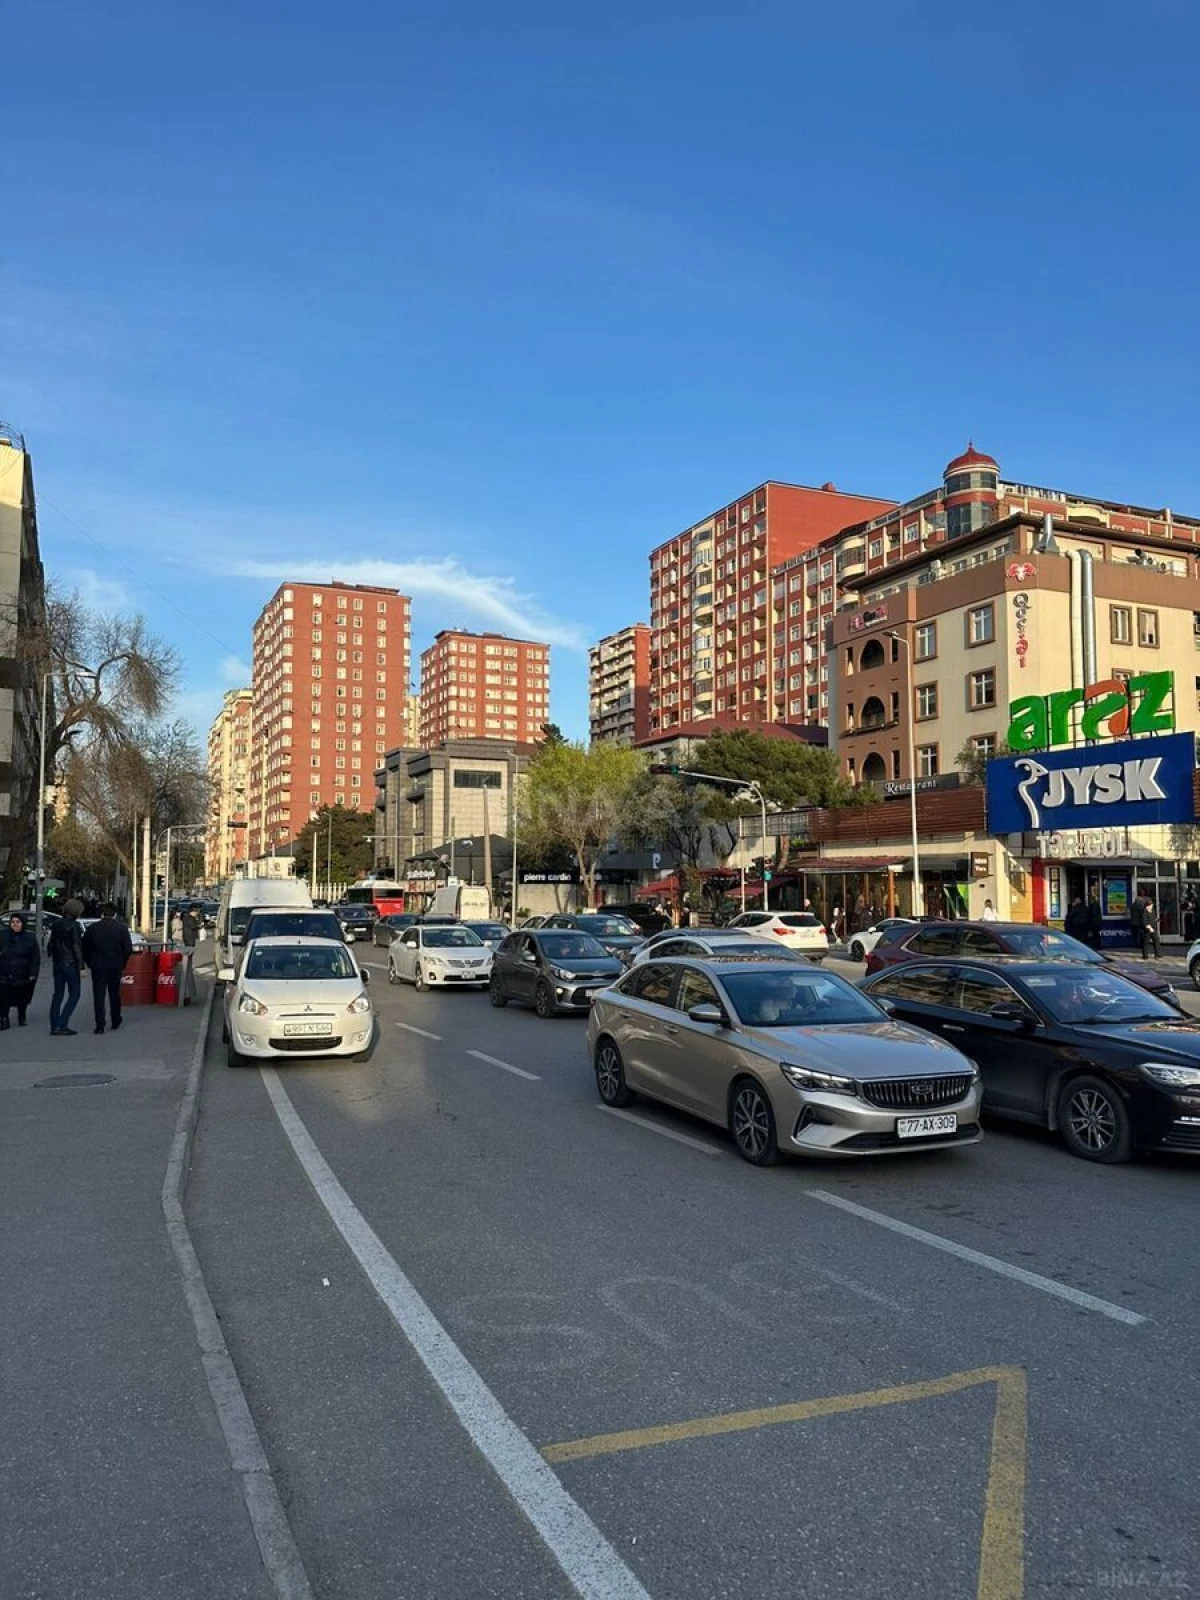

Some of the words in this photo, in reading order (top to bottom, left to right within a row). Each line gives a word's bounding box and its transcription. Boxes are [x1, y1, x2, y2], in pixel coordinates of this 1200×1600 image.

[1007, 670, 1176, 751] araz
[884, 780, 936, 795] Restarant
[1041, 756, 1167, 808] JYSK
[523, 873, 546, 884] pierre
[547, 872, 571, 881] cardin
[907, 1116, 955, 1133] 77-AX-309
